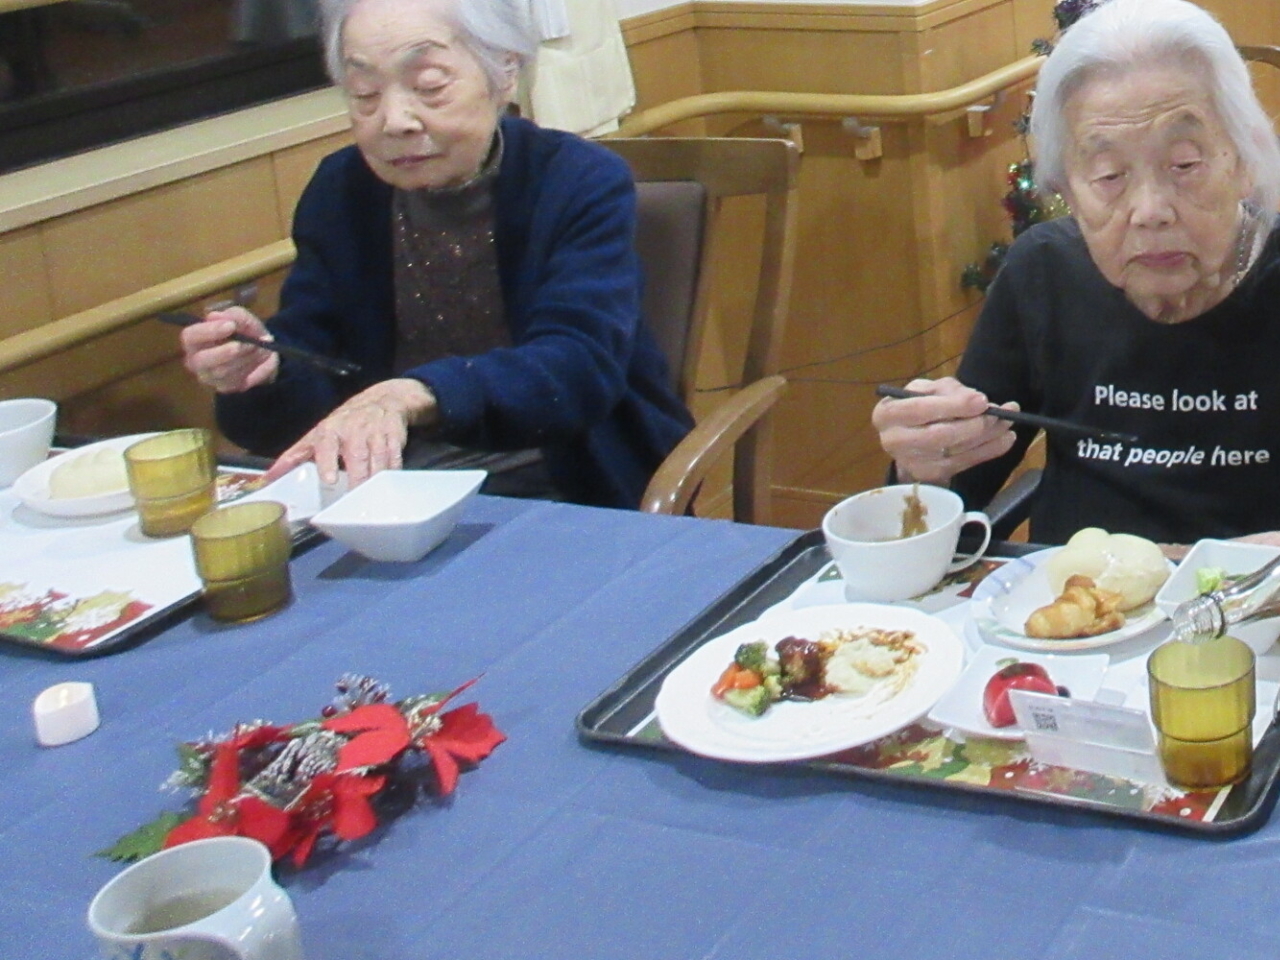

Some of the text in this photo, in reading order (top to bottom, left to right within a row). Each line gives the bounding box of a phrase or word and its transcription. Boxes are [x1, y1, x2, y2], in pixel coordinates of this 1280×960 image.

[1094, 384, 1259, 412] Please look at
[1076, 437, 1271, 468] that people here
